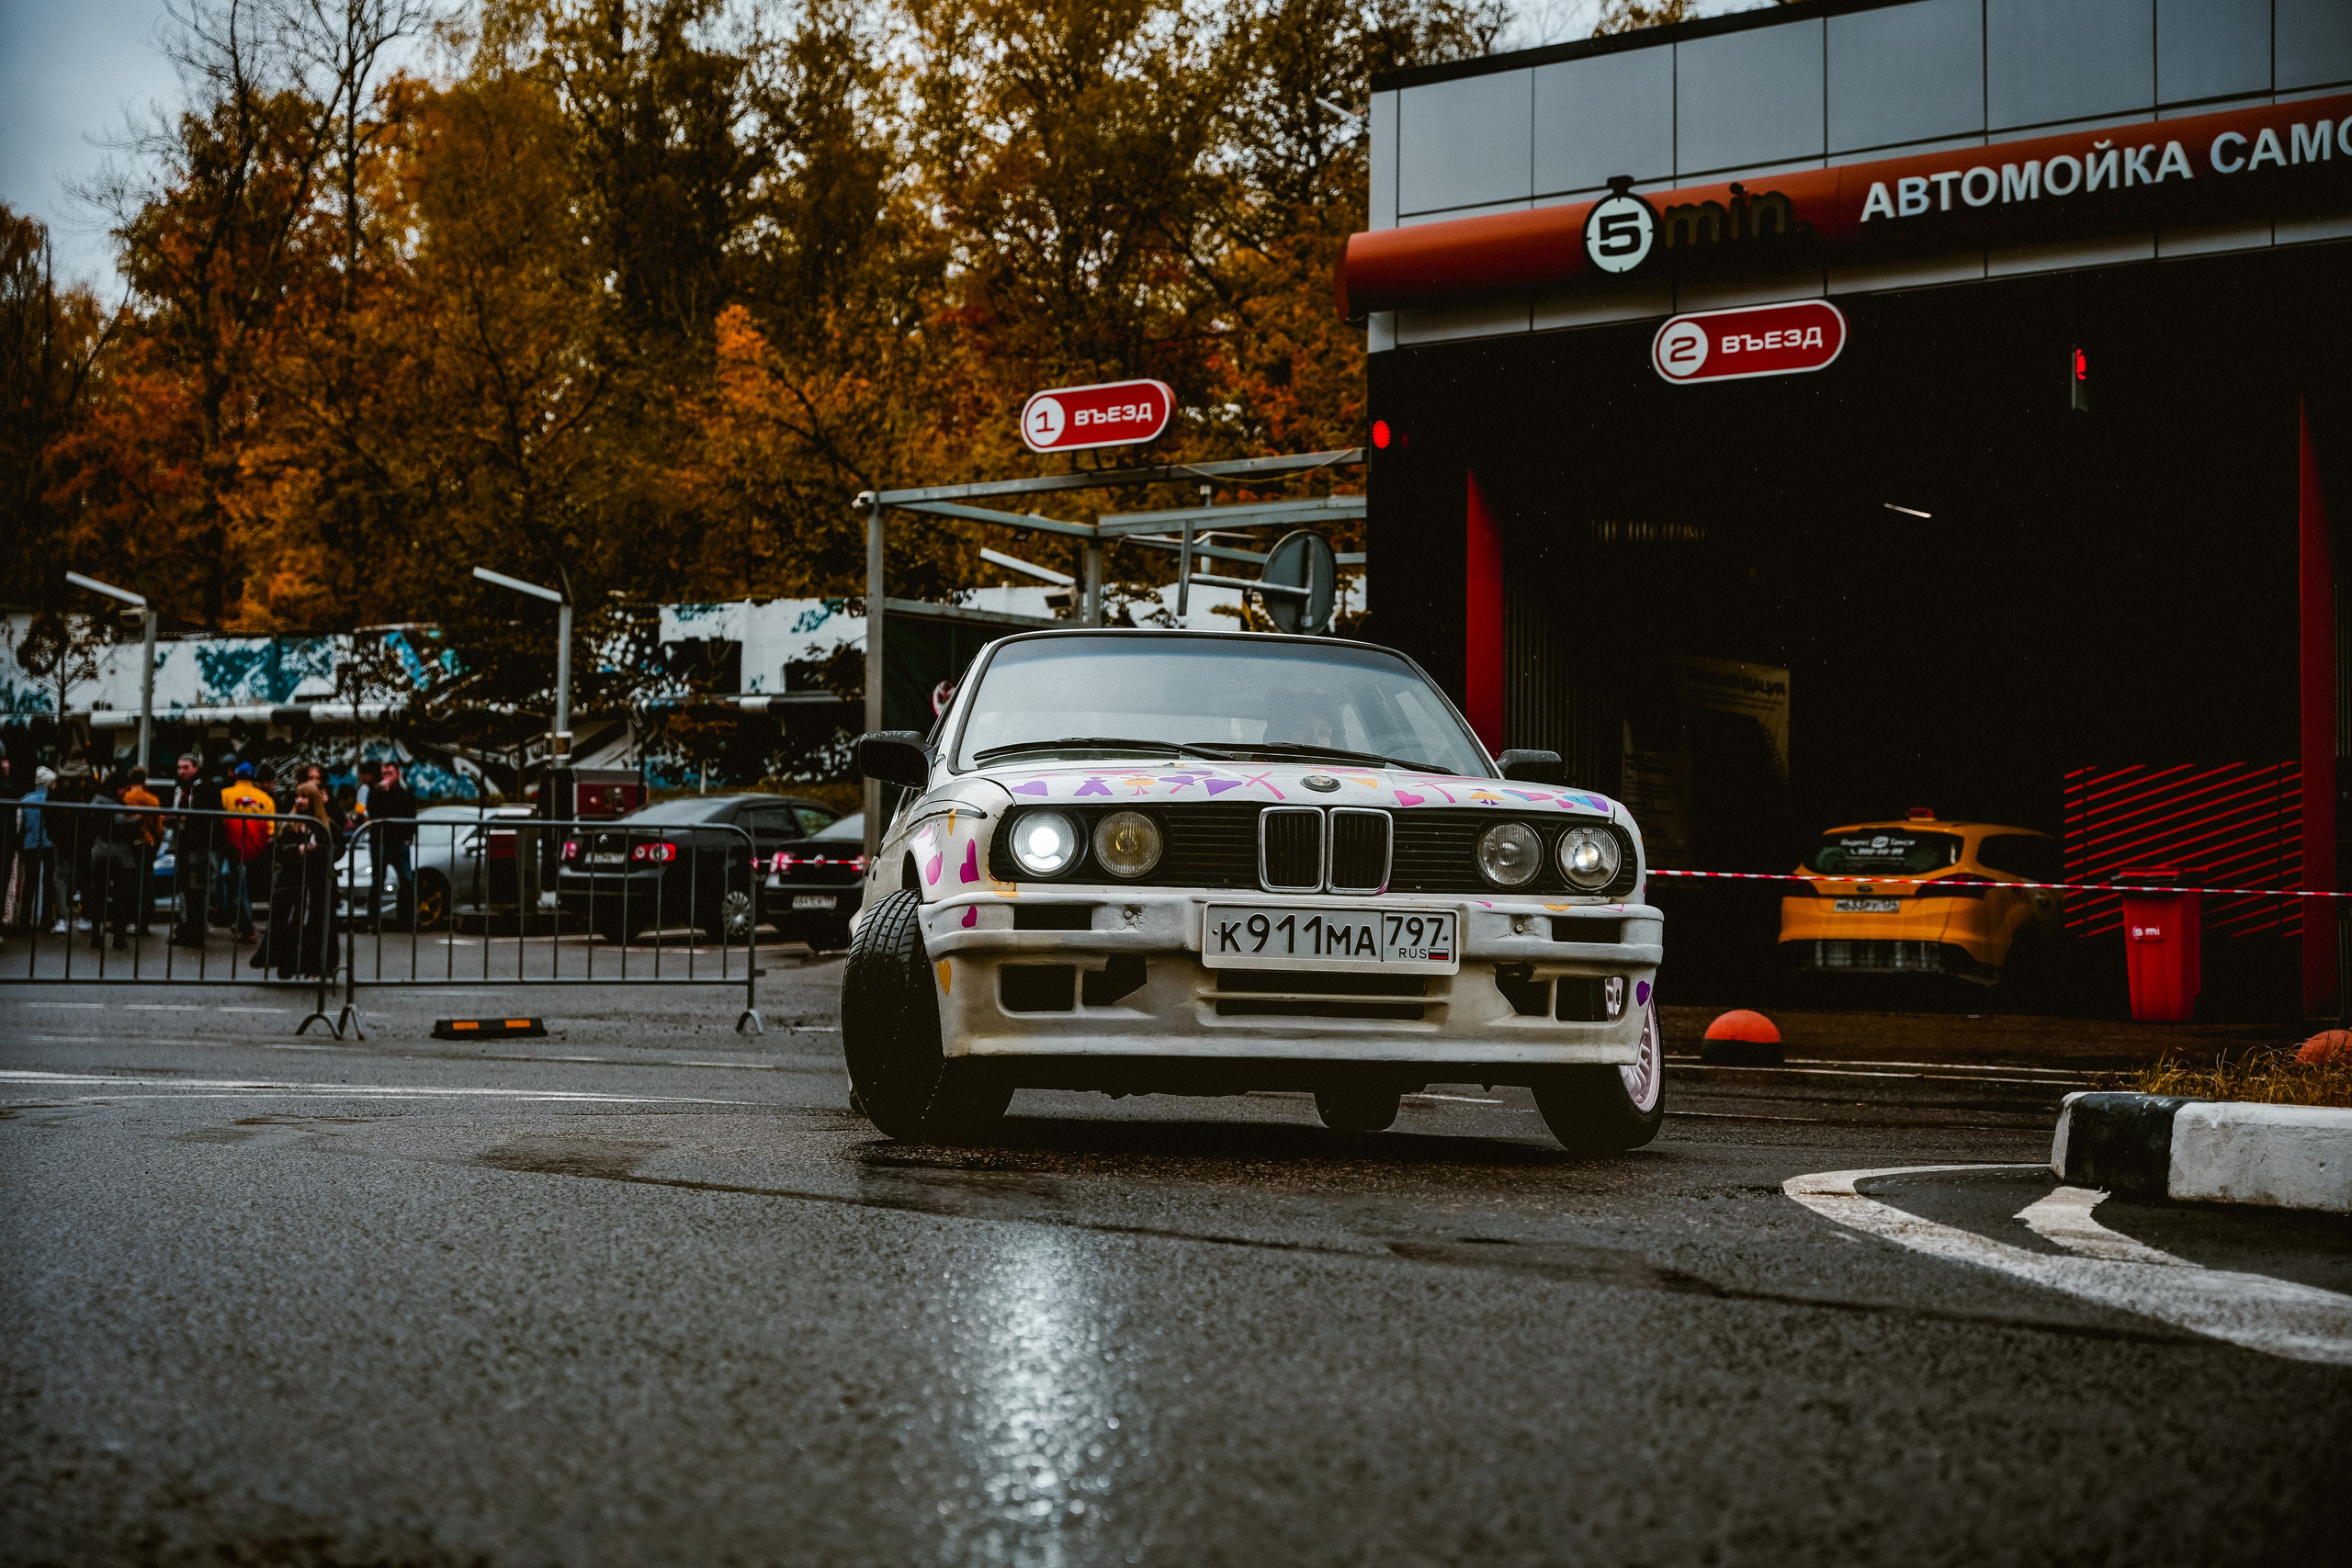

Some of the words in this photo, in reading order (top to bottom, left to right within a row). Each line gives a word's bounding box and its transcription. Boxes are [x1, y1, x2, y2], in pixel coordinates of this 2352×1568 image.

[1860, 140, 2194, 222] АВТОМОЙКА
[1599, 212, 1642, 256] 5
[1670, 335, 1697, 363] 2
[1722, 326, 1824, 354] ВЪЕЗД
[1035, 411, 1055, 433] 1
[1074, 402, 1153, 426] ВЪЕЗД
[1219, 913, 1377, 956] К911МА
[1385, 916, 1445, 946] 797
[1398, 947, 1428, 960] RUS
